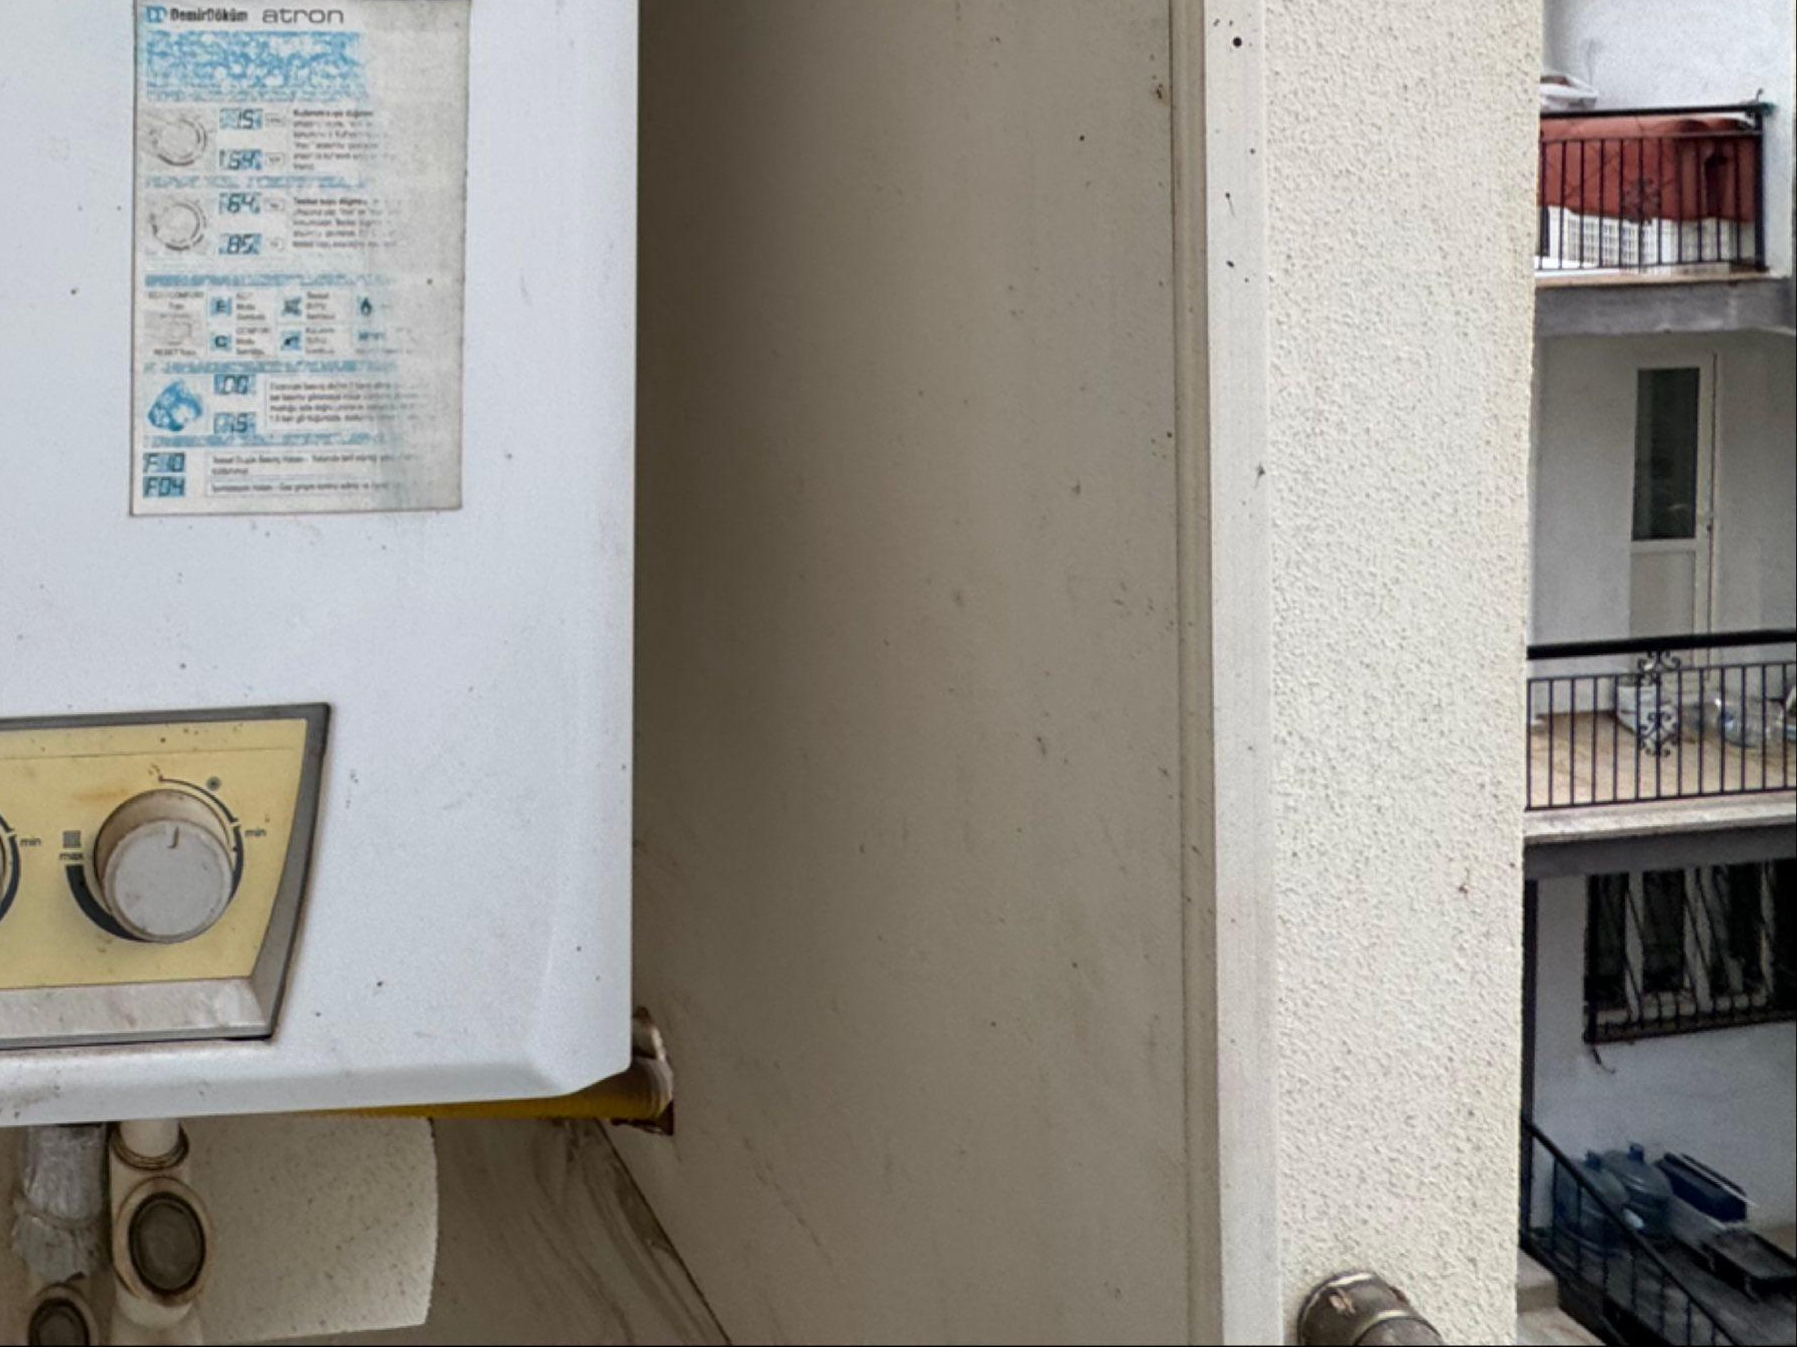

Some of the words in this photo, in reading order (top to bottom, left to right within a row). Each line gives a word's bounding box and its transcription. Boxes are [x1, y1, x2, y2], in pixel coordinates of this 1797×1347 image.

[262, 7, 344, 24] atron
[244, 827, 267, 838] min
[19, 836, 42, 847] min
[58, 851, 84, 862] max
